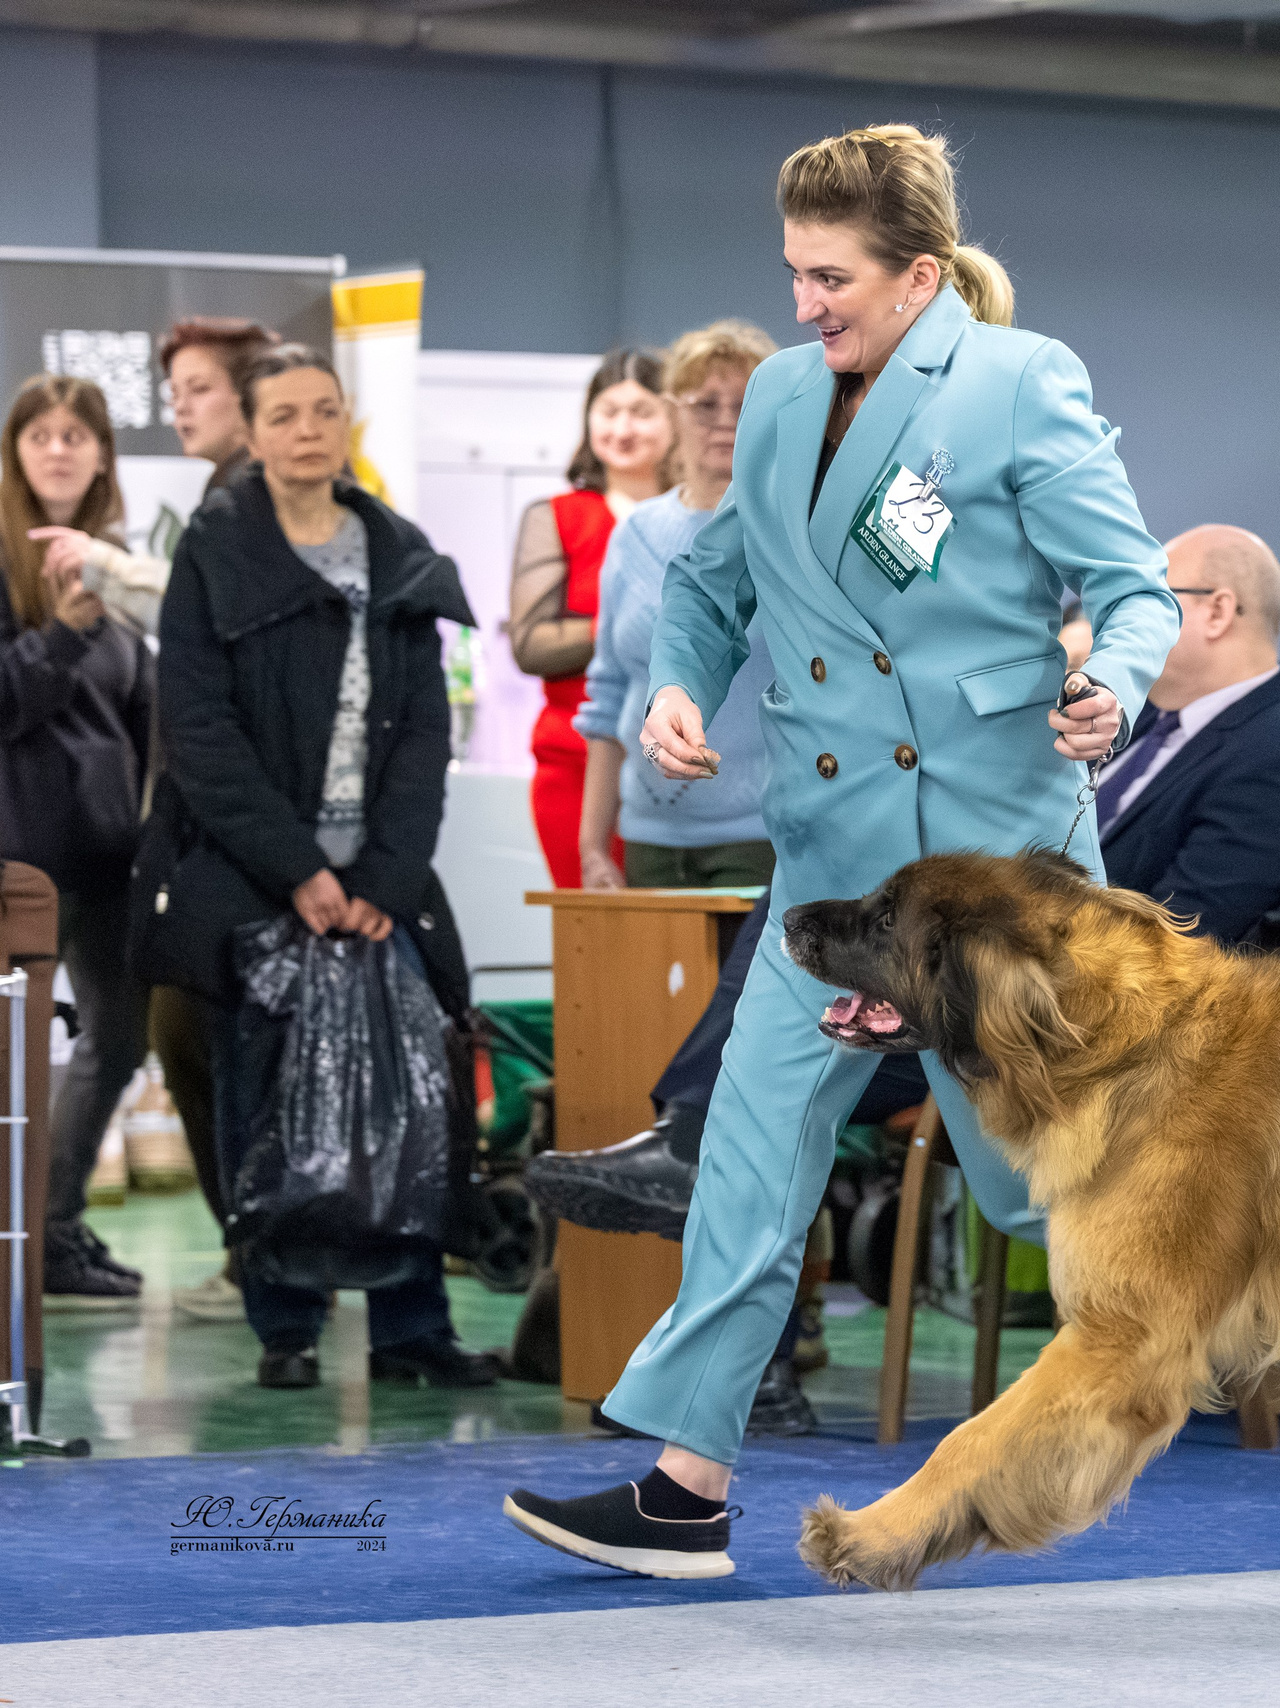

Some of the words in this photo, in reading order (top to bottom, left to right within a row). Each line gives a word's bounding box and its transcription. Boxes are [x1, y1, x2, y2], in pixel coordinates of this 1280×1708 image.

[888, 482, 945, 534] 23
[857, 526, 882, 552] ARDEN
[878, 549, 907, 581] GRANGE
